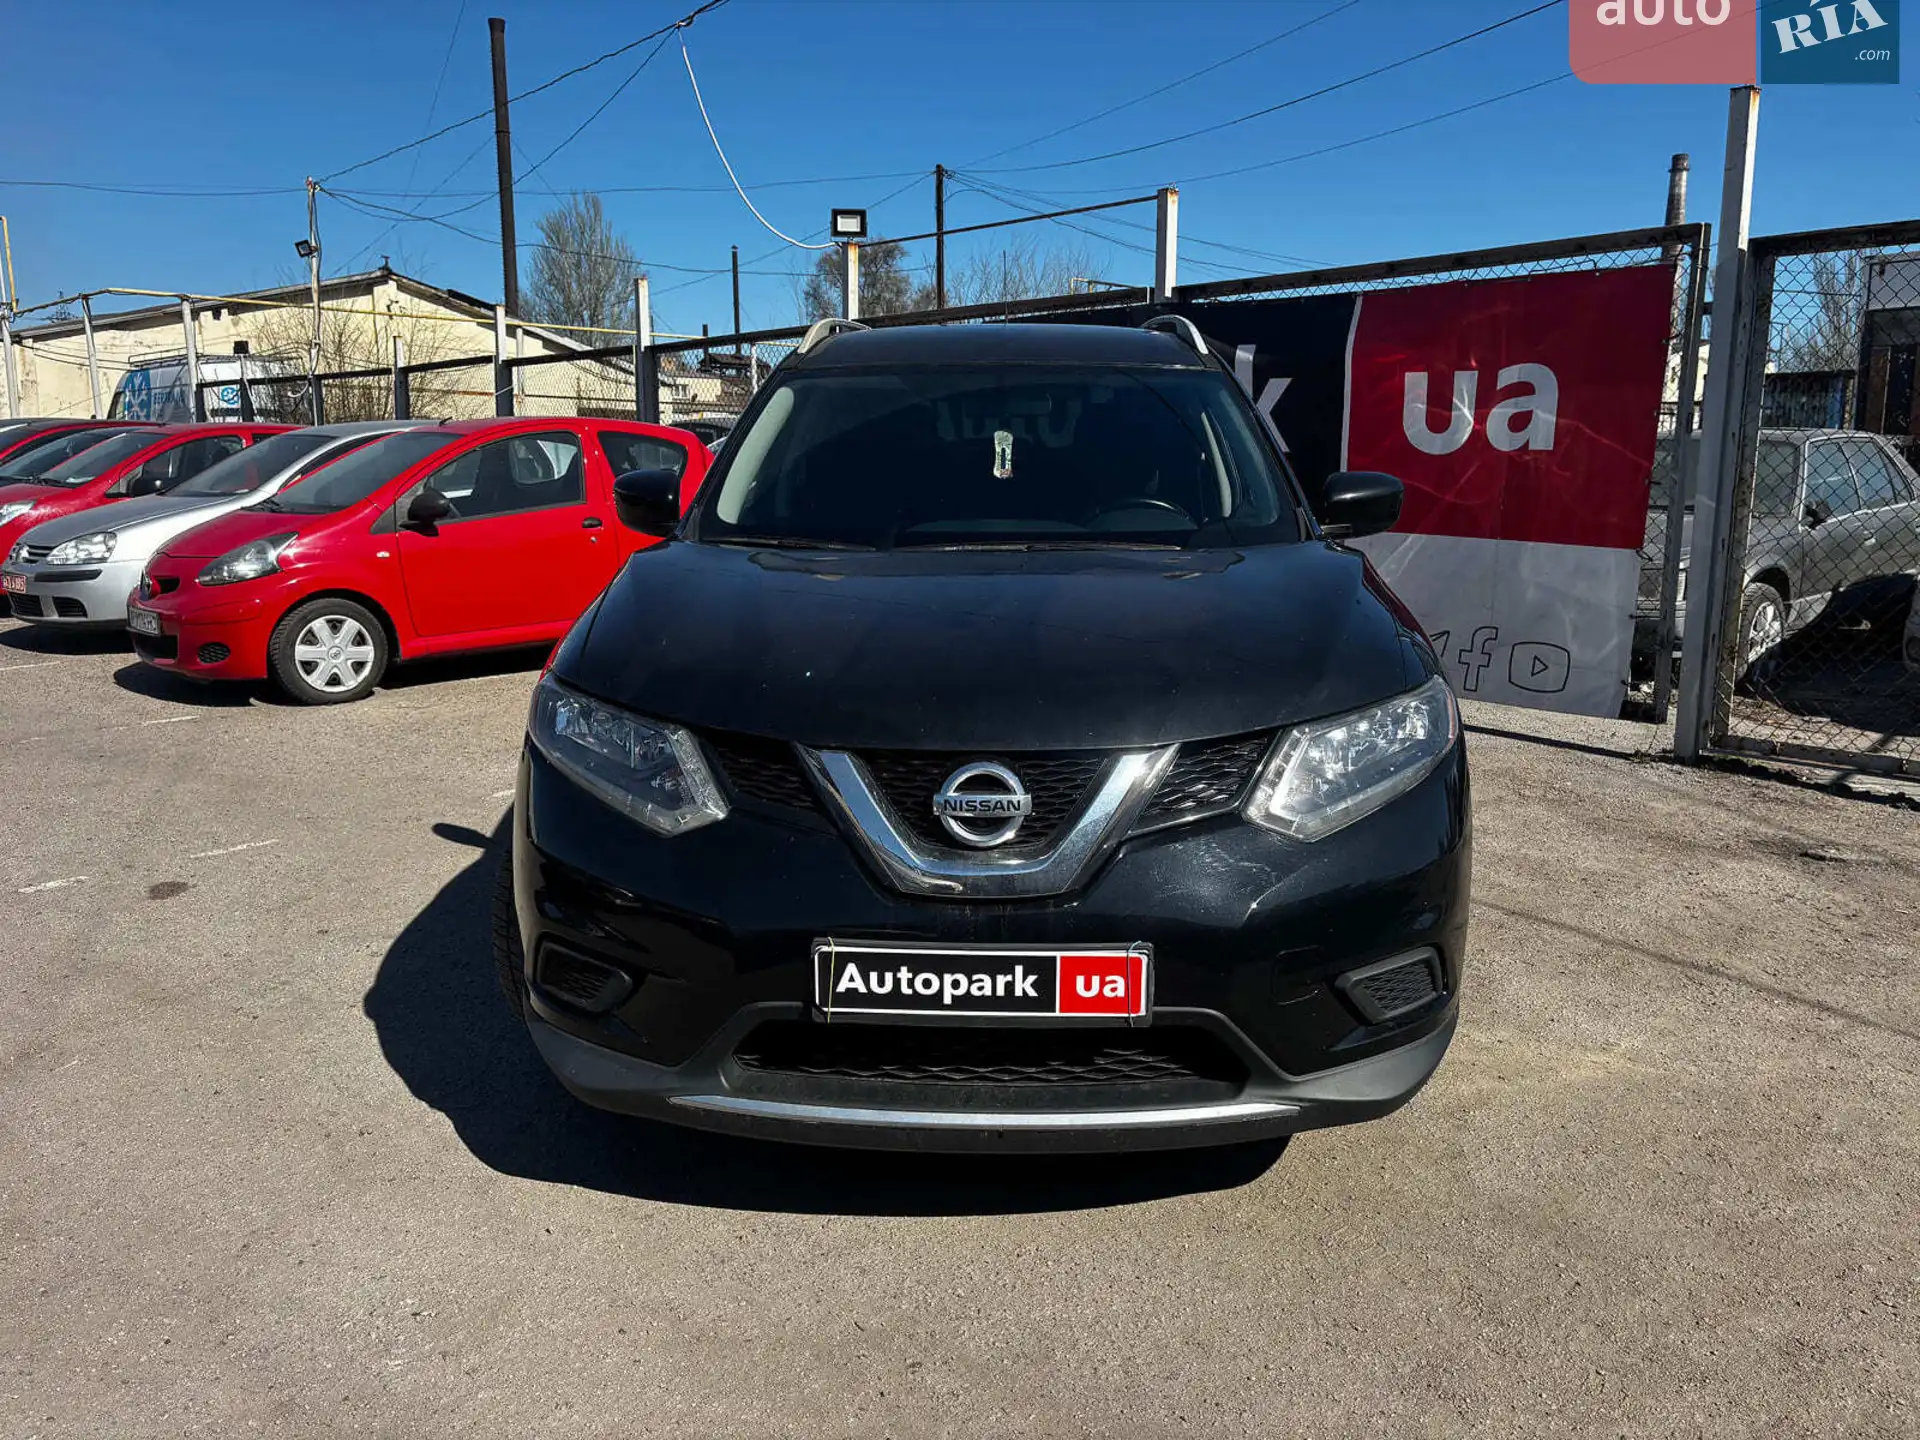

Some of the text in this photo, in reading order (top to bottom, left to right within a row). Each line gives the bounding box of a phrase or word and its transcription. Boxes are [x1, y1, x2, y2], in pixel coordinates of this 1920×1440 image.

[1402, 362, 1559, 456] ua
[943, 799, 1021, 813] NISSAN
[835, 962, 1126, 1005] Autopark ua
